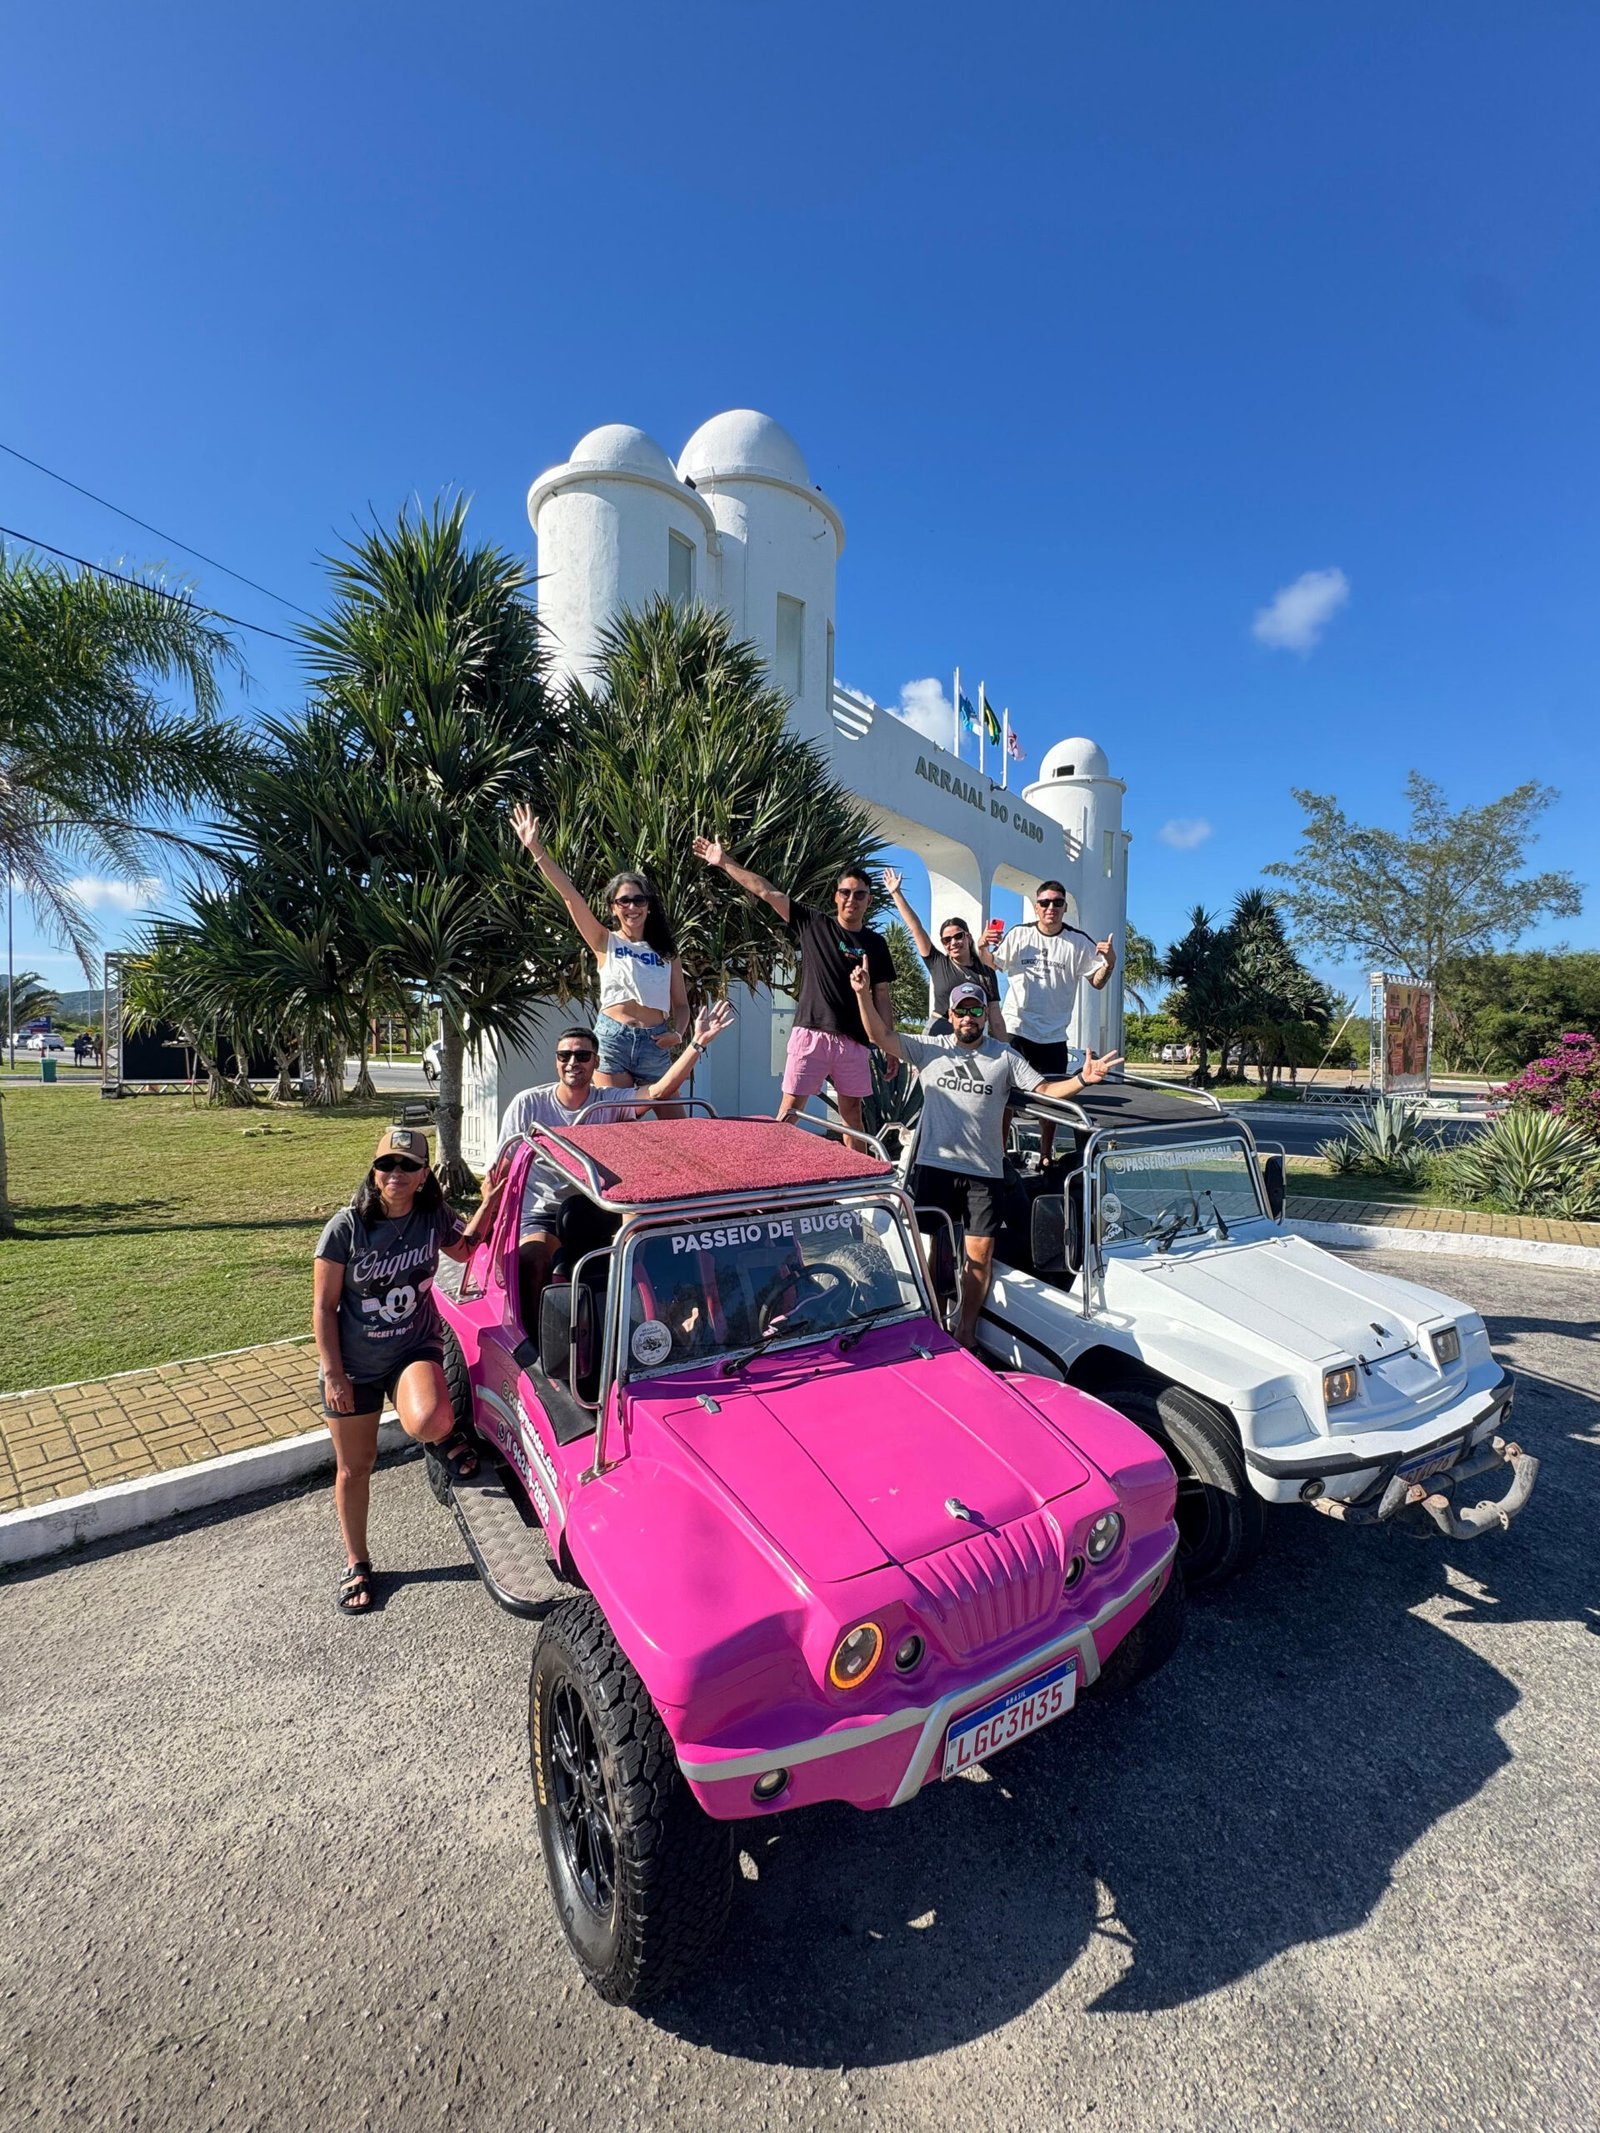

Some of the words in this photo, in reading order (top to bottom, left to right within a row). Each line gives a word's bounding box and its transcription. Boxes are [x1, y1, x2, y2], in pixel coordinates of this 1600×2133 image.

[915, 756, 986, 812] ARRAIAL
[990, 799, 1009, 823] DO
[1013, 813, 1044, 844] CABO
[936, 1074, 993, 1096] adidas
[353, 1228, 434, 1287] Original
[672, 1225, 762, 1254] PASSEIO
[767, 1219, 795, 1239] DE
[800, 1211, 861, 1235] BUGGY
[957, 1681, 1064, 1767] LGC3H35
[1005, 1691, 1027, 1707] BRASIL
